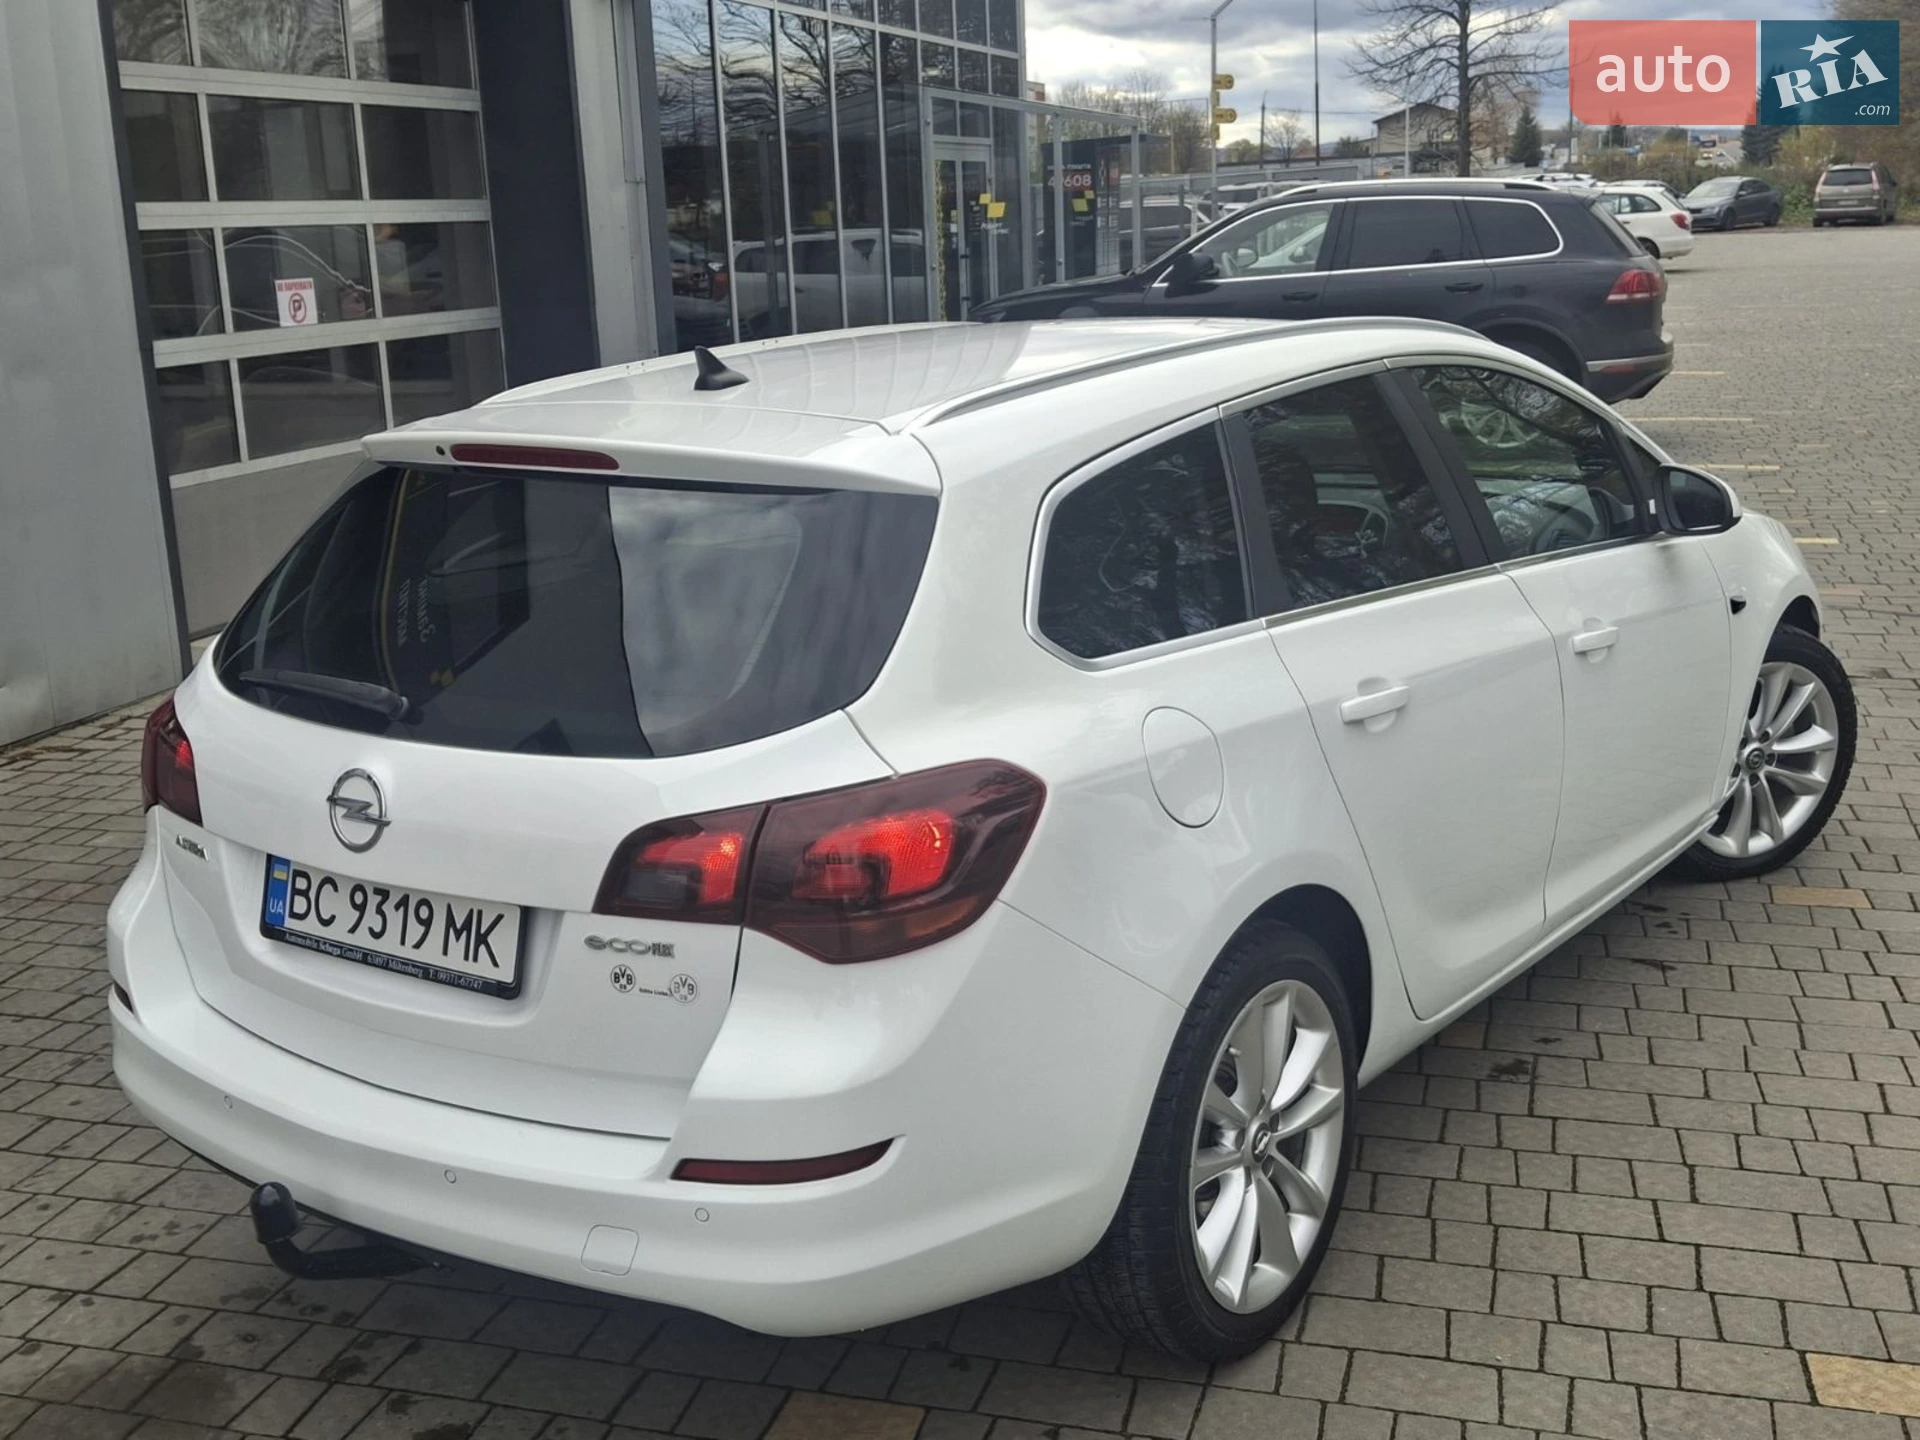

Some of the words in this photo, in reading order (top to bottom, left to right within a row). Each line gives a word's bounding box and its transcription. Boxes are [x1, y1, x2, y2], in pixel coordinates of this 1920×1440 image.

[269, 898, 285, 916] UA
[288, 868, 339, 928] BC
[347, 883, 434, 950] 9319
[442, 902, 505, 969] MK
[342, 947, 363, 961] GmbH
[613, 966, 633, 986] BVB
[673, 976, 695, 996] BVB
